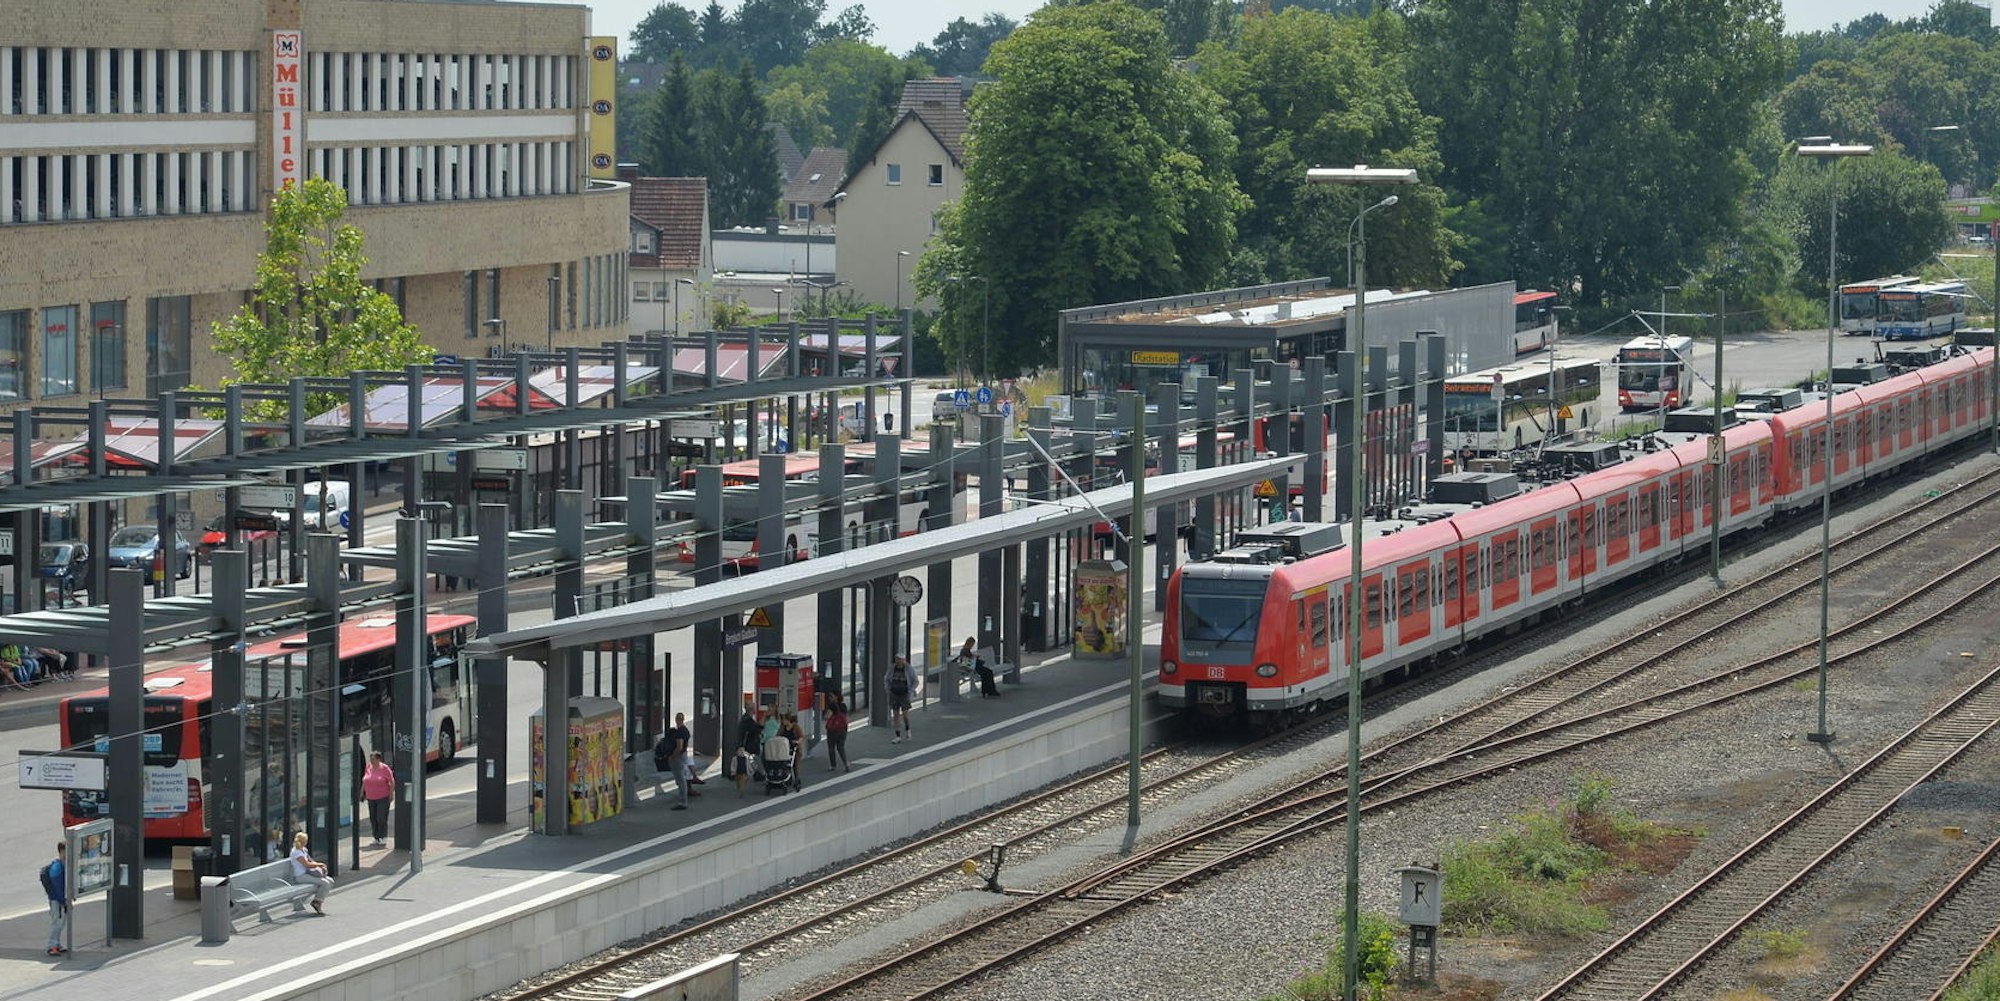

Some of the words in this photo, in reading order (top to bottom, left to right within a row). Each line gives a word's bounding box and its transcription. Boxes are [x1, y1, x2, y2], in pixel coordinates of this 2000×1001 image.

[282, 41, 293, 51] M
[275, 64, 299, 191] Müller
[1712, 438, 1719, 450] 9
[284, 493, 294, 502] 10
[1, 538, 9, 548] 11
[1210, 668, 1222, 678] DB
[27, 766, 33, 776] 7
[1415, 882, 1425, 904] F
